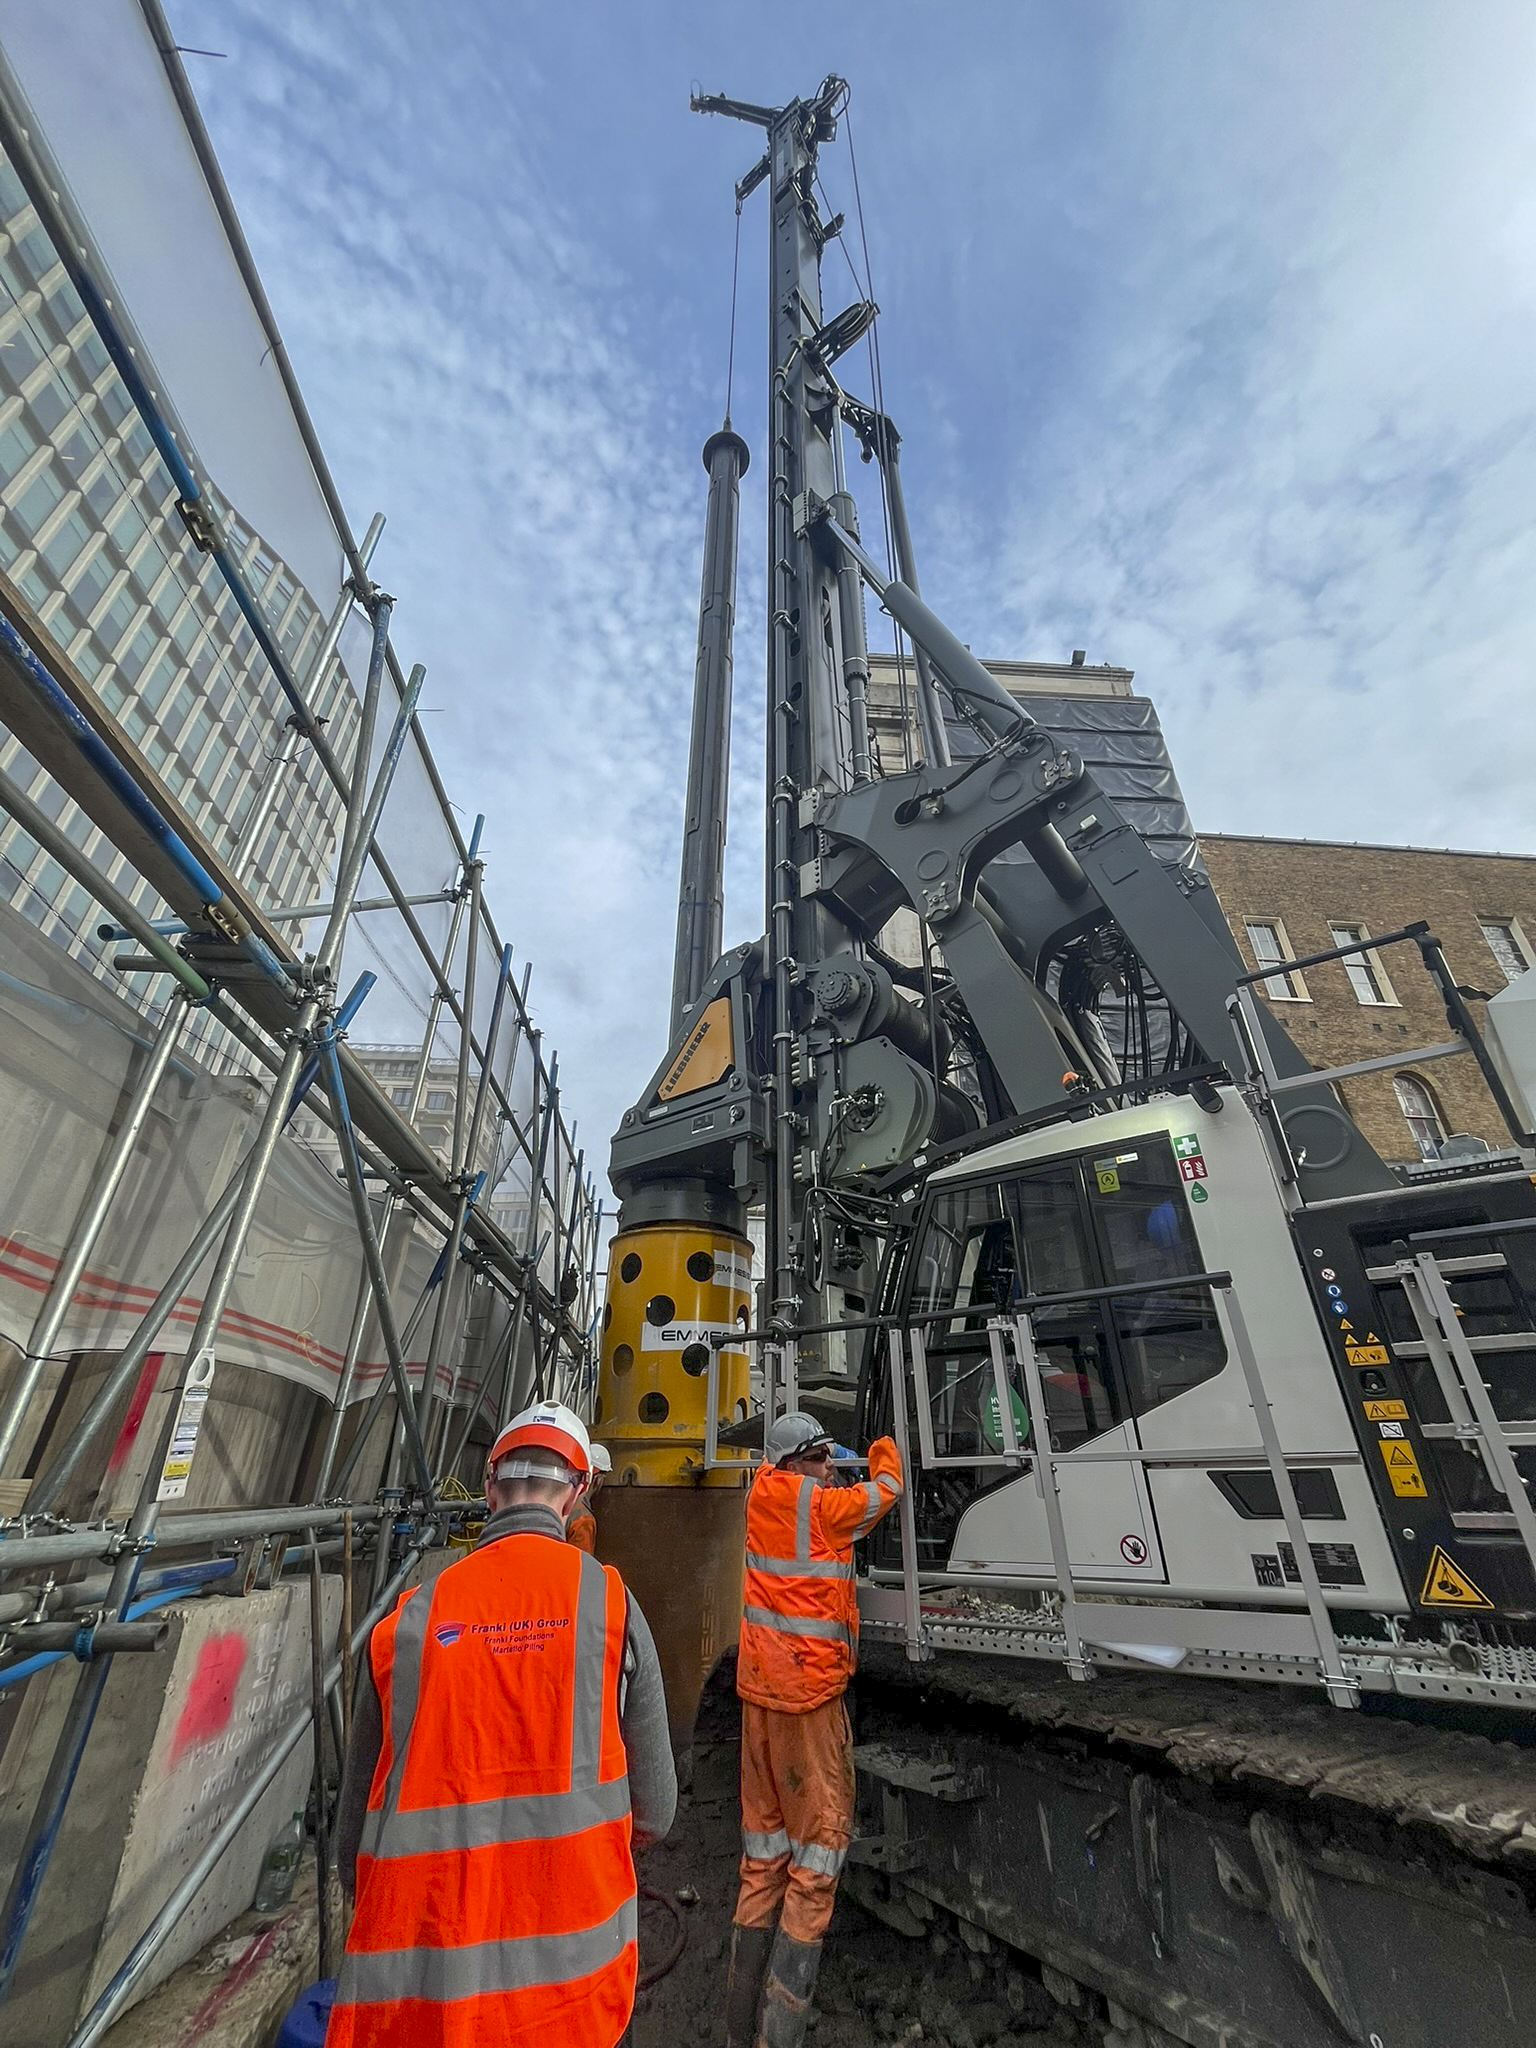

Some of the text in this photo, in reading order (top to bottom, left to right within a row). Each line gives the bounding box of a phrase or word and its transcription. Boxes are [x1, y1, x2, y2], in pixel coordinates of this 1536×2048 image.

[471, 1618, 569, 1633] Franki (UK) Group
[484, 1632, 554, 1645] Franki Foundations
[523, 1643, 545, 1652] Piling
